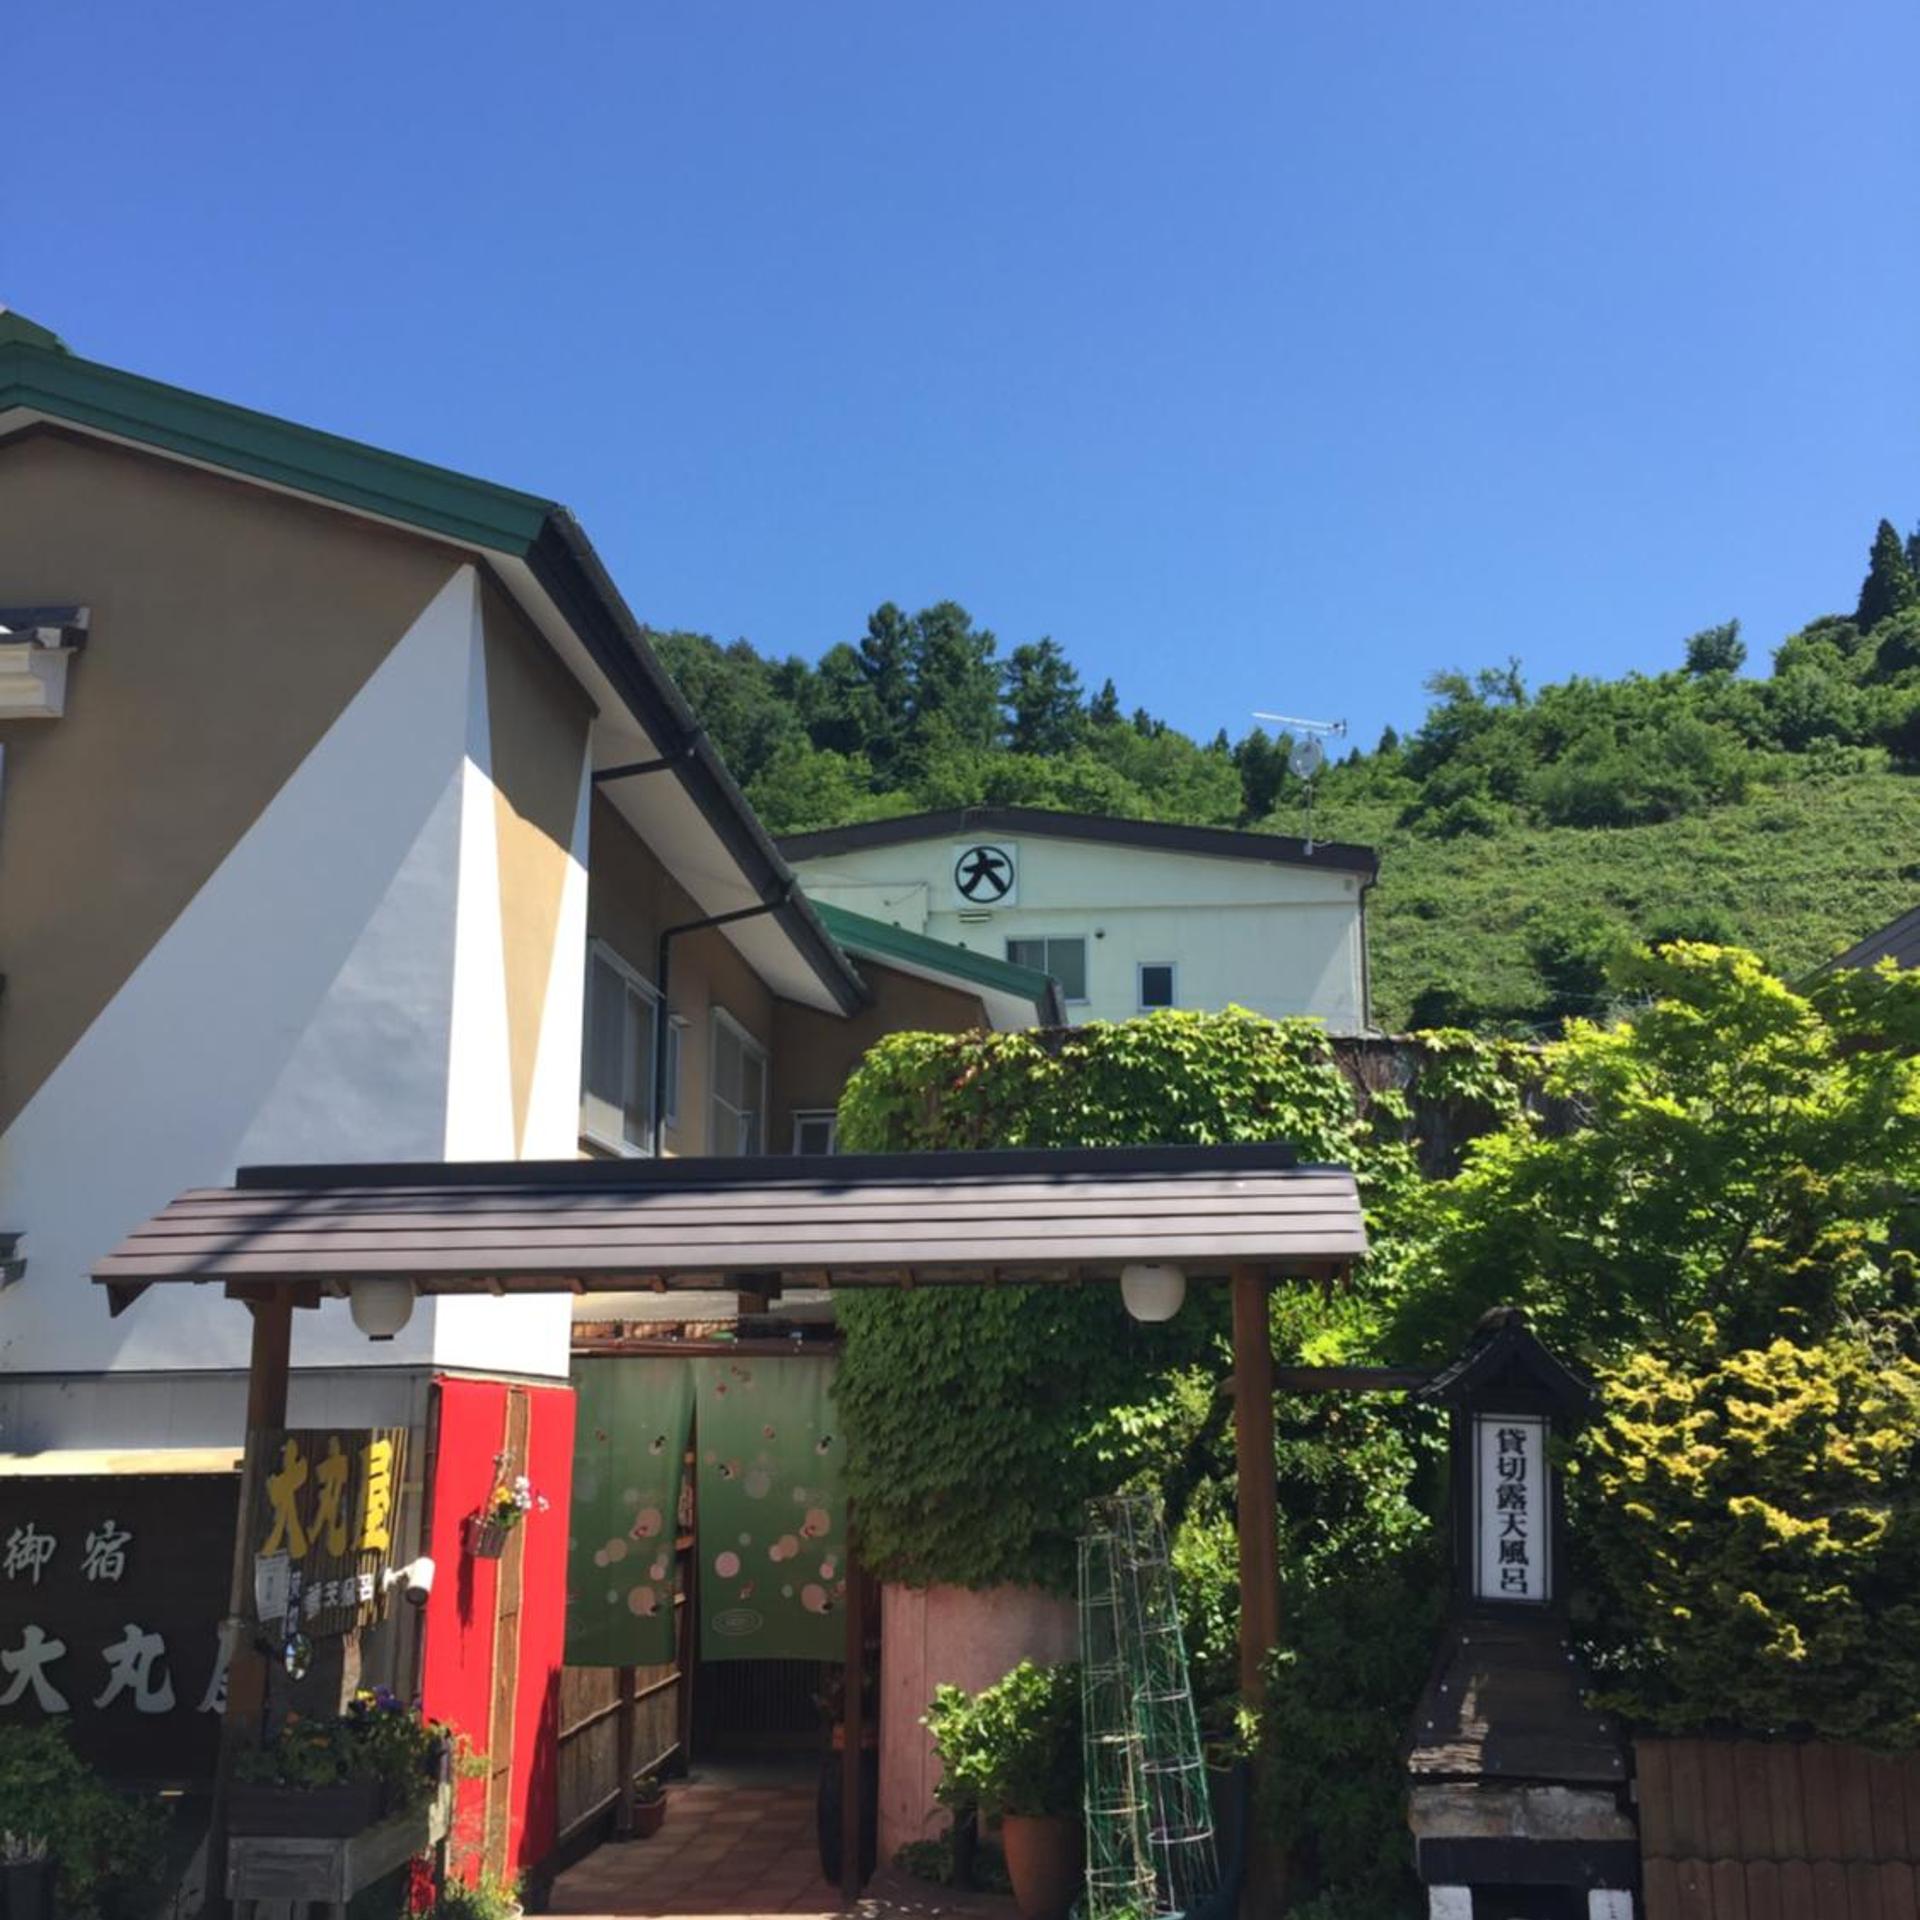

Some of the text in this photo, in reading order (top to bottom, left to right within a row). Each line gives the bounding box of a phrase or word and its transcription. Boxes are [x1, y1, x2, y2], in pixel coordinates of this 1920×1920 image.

[962, 849, 1006, 895] 大
[262, 1436, 393, 1558] 大丸屋
[1496, 1428, 1529, 1595] 貸切露天風呂
[3, 1520, 133, 1584] 御宿
